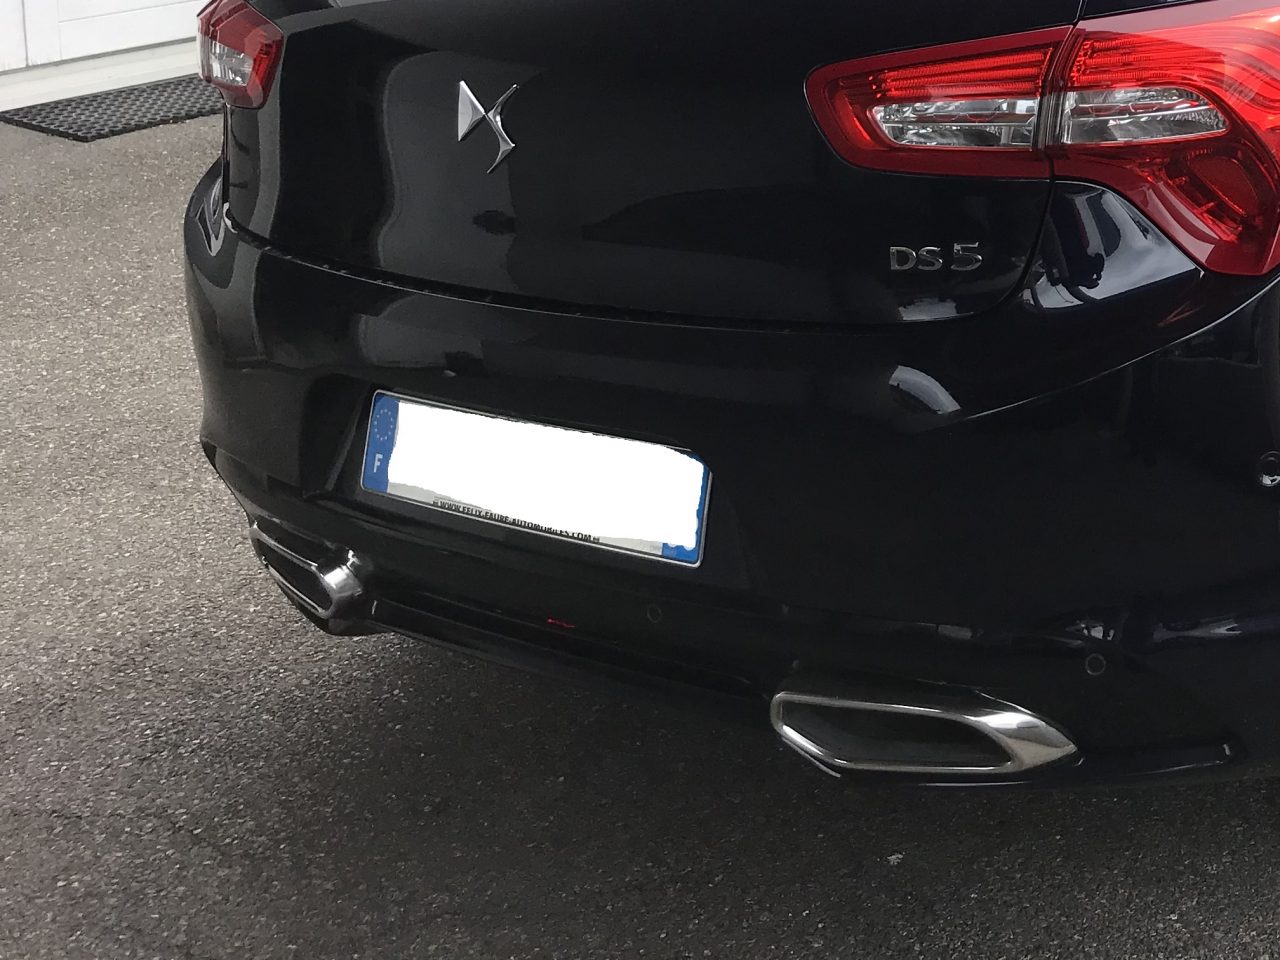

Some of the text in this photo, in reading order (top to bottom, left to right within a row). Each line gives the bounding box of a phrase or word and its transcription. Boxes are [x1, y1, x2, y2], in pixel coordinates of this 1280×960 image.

[889, 241, 983, 271] DS 5
[372, 452, 383, 473] F
